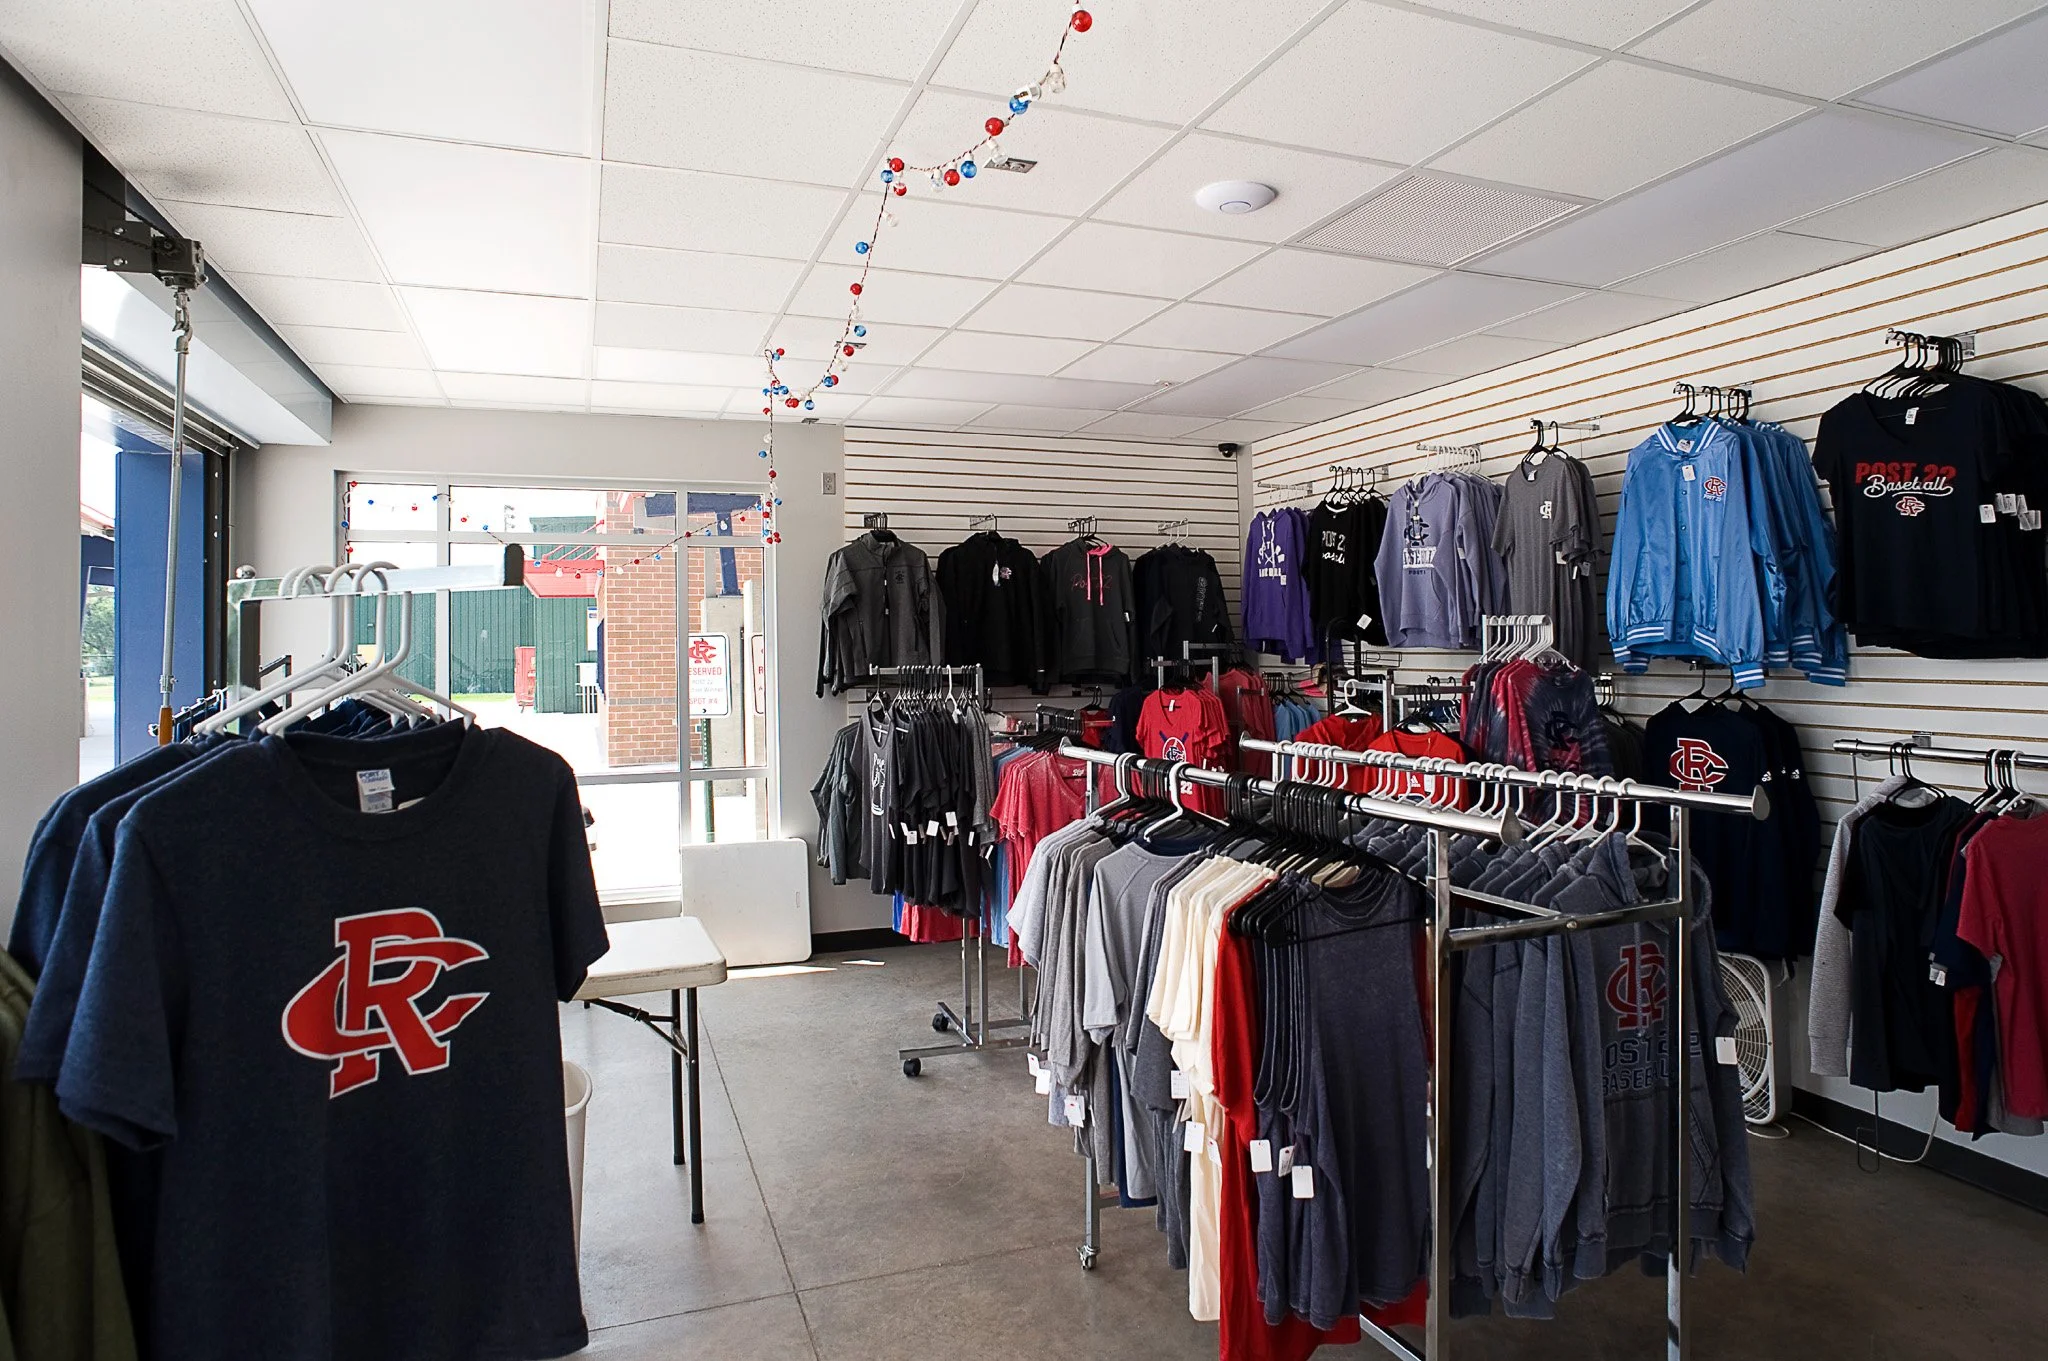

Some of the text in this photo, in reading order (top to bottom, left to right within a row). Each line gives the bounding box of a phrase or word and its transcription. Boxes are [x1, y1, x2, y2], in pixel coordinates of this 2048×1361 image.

[1855, 461, 1917, 485] POST
[688, 667, 722, 675] ESERVED
[1604, 1036, 1654, 1070] OST
